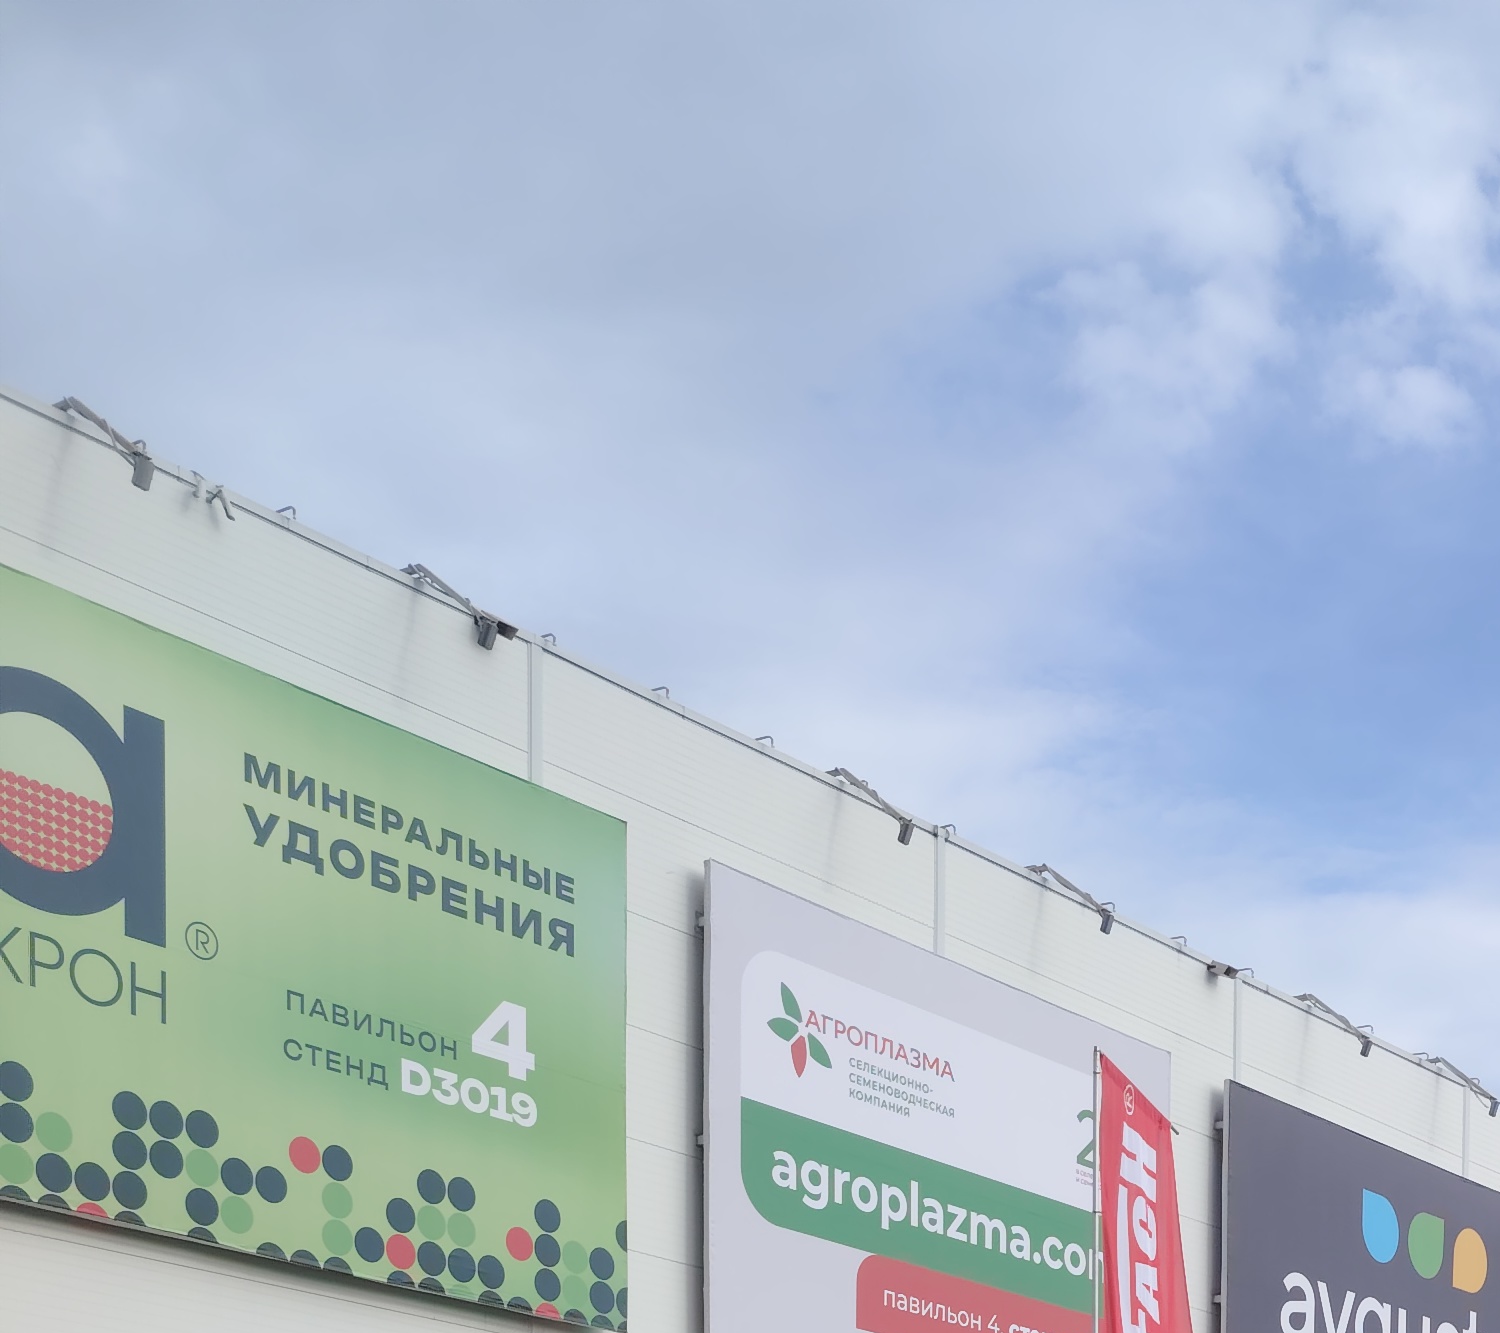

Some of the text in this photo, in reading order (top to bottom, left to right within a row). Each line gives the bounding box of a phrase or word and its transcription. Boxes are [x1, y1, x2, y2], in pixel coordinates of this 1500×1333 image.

[244, 752, 575, 905] МИНЕРАЛЬНЫЕ
[242, 804, 576, 957] УДОБРЕНИЯ
[0, 925, 167, 1025] КРОН
[285, 989, 535, 1082] ПАВИЛЬОН 4
[805, 1010, 955, 1082] АГРОПЛАЗМА
[849, 1057, 934, 1094] СЕЛЕКЦИОННО-
[282, 1038, 537, 1128] СТЕНД D3019
[849, 1073, 955, 1118] СЕМЕНОВОДЧЕСКАЯ
[849, 1088, 910, 1117] КОМПАНИЯ
[883, 1287, 983, 1332] павильон
